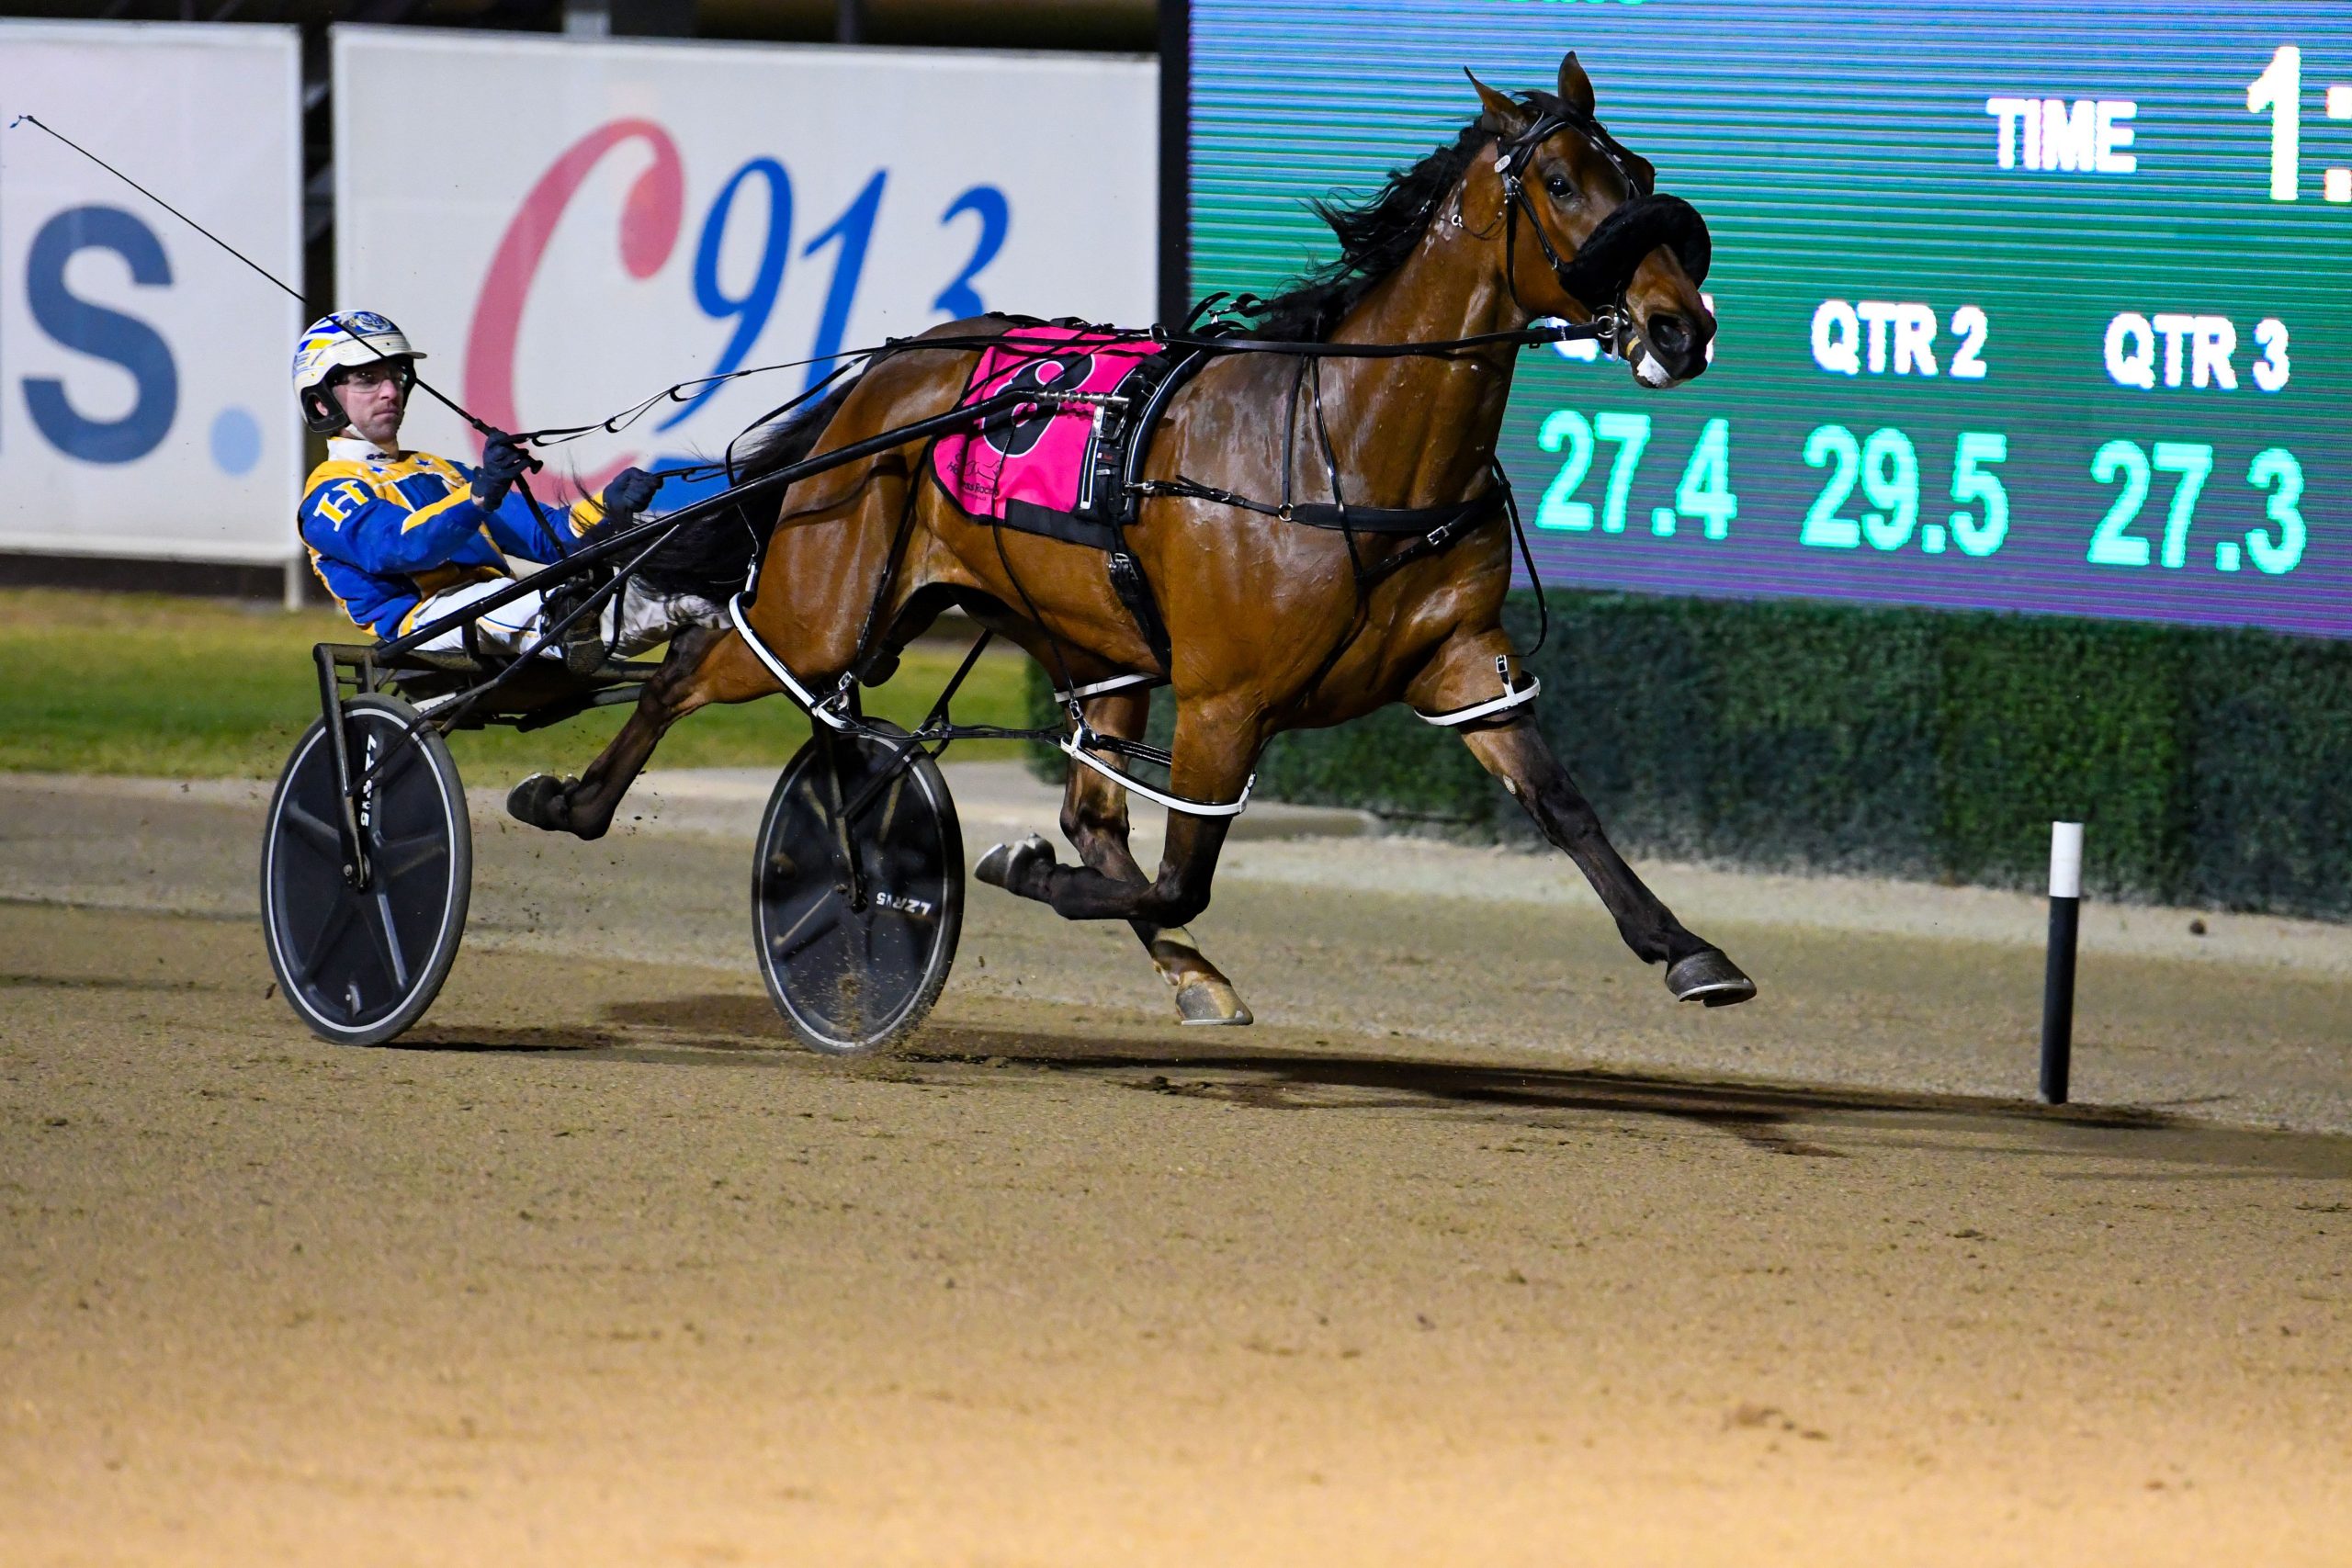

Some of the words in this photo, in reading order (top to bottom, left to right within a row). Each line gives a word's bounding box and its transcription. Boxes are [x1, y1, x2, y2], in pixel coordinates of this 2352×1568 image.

[1986, 97, 2137, 173] TIME
[1811, 300, 1938, 375] QTR
[1950, 306, 1988, 378] 2
[2104, 313, 2238, 389] QTR
[2253, 319, 2290, 391] 3
[981, 352, 1096, 458] 8
[312, 479, 369, 532] H
[1535, 410, 1737, 540] 27.4
[1800, 424, 2009, 557] 29.5
[2086, 440, 2307, 574] 27.3
